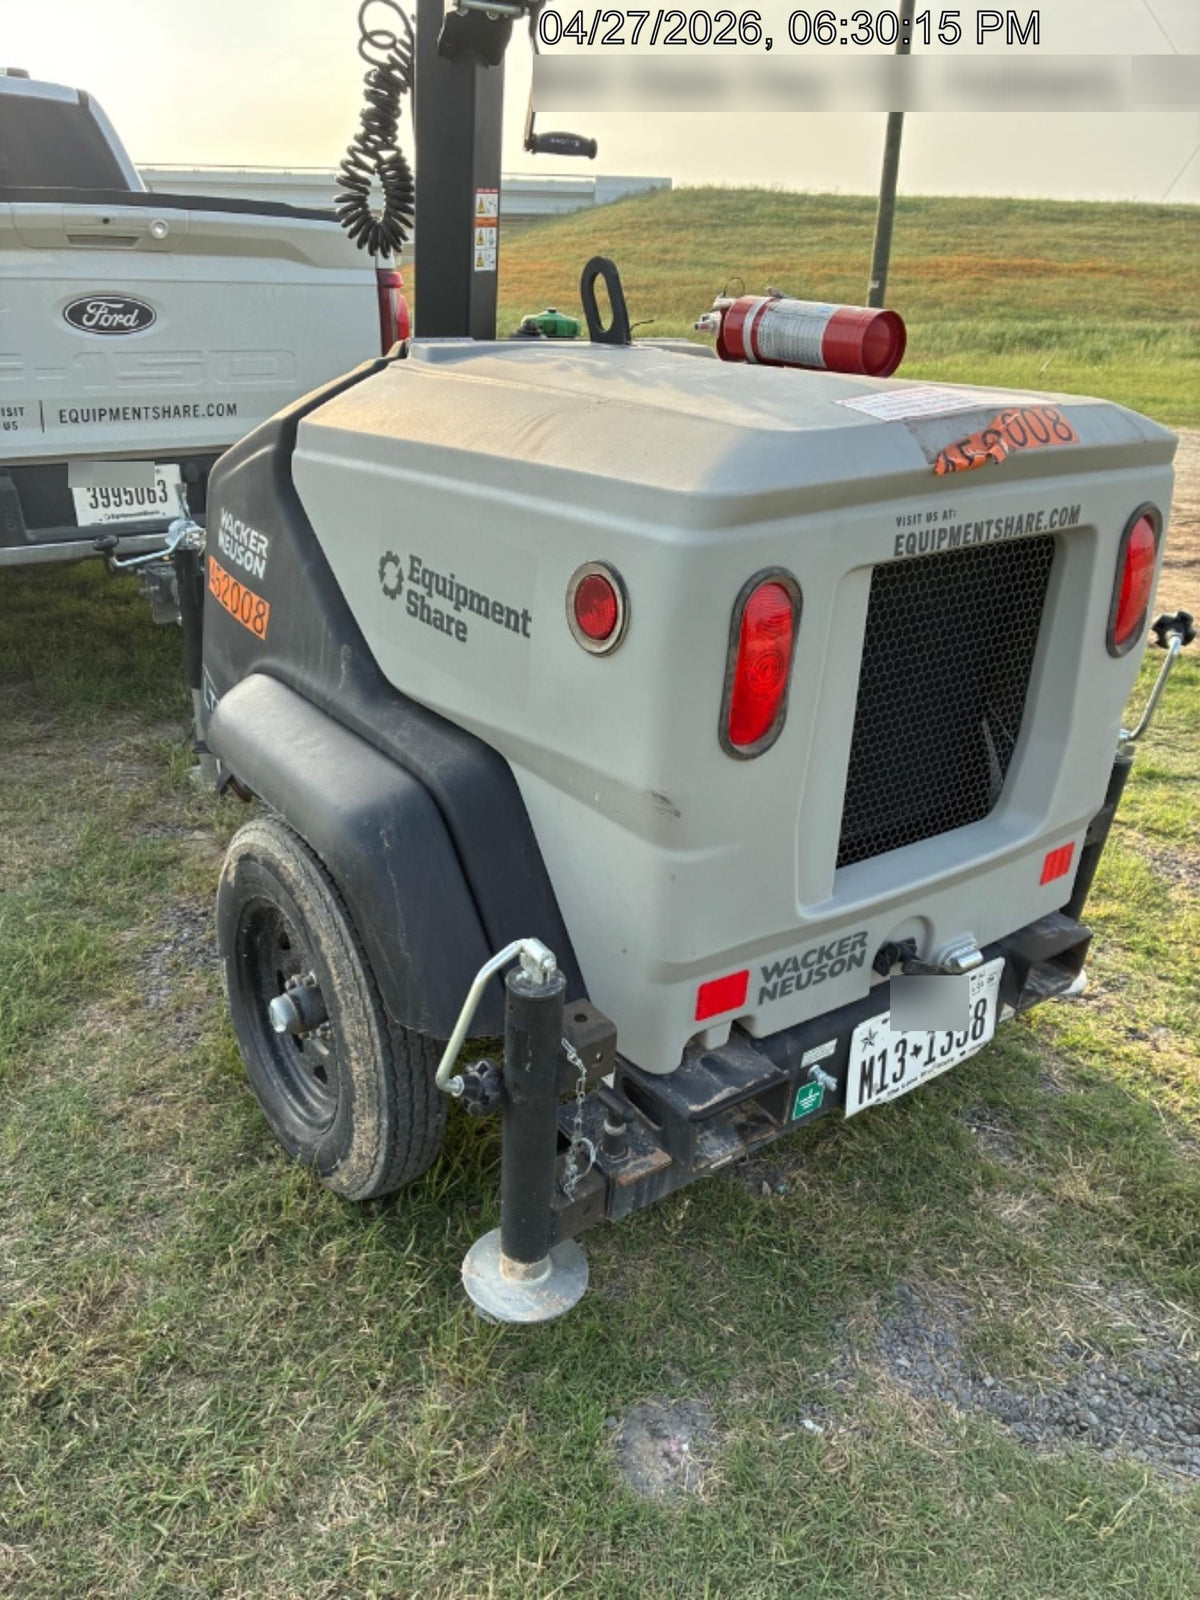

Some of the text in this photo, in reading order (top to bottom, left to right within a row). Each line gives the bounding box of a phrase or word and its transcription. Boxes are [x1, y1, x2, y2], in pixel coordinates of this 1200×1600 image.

[82, 301, 140, 327] Ford
[1, 403, 238, 424] ISIT EQUIPMENTSHARE.COM
[3, 421, 18, 431] US
[221, 507, 269, 559] WACKER
[894, 504, 1082, 557] EQUIPMENTSHARE.COM
[896, 512, 923, 528] VISIT
[925, 510, 939, 524] US
[218, 531, 266, 580] NEUSON
[406, 588, 469, 643] Share
[407, 554, 533, 639] Equipment
[758, 949, 867, 1006] NEUSON
[761, 931, 869, 984] WACKER
